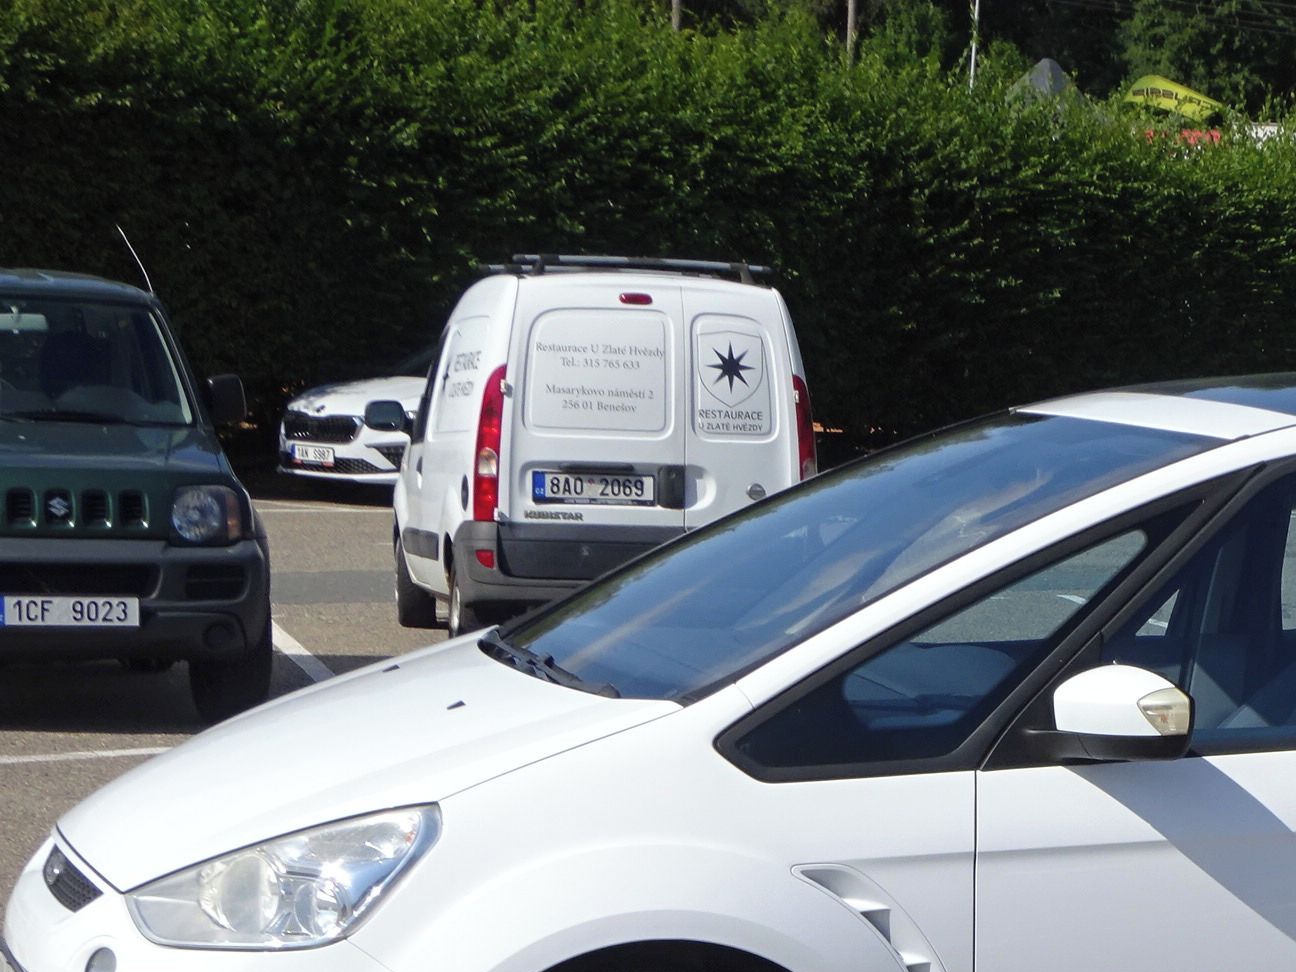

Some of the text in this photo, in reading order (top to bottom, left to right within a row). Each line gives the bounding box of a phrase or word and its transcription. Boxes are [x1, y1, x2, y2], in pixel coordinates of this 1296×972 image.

[536, 342, 588, 353] Restaurace
[590, 344, 600, 353] U
[602, 344, 627, 356] Zlaté
[583, 358, 600, 369] 315
[545, 384, 605, 397] Masarykovo
[648, 390, 654, 399] 2
[562, 400, 637, 413] 256 01 Benešov
[699, 409, 763, 421] RESTAURACE
[600, 478, 644, 497] 2069
[13, 600, 128, 622] 1CF 9023
